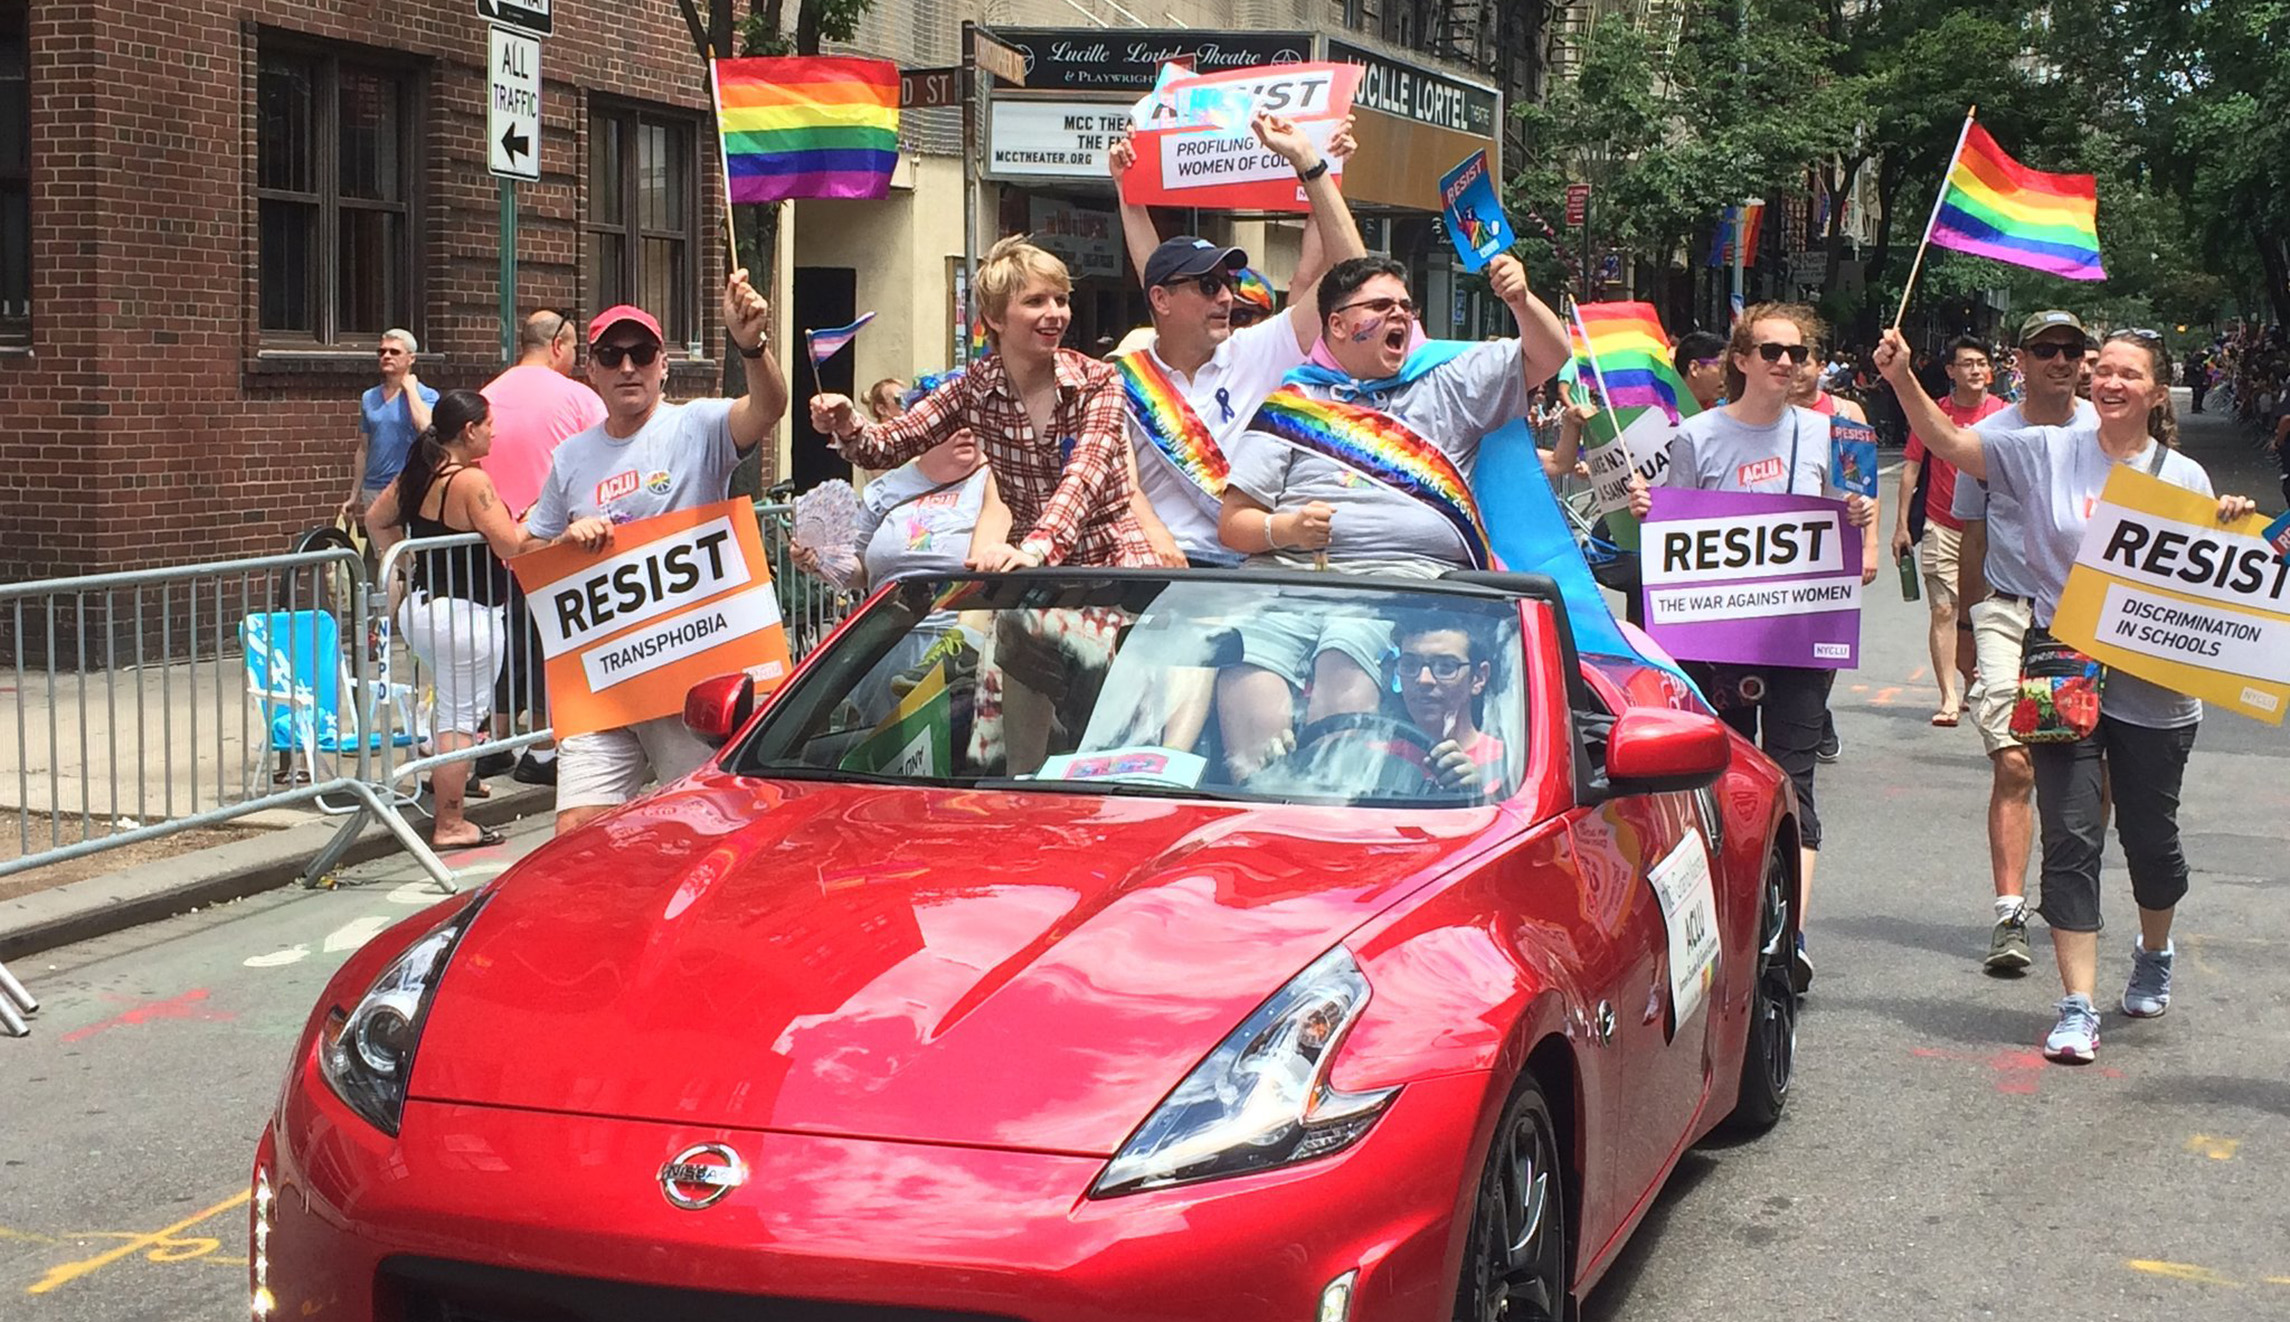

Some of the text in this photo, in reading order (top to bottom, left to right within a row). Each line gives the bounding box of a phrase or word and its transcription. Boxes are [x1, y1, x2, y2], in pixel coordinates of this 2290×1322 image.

[502, 42, 528, 79] ALL
[1047, 41, 1111, 63] Lucille
[1195, 42, 1261, 66] Theatre
[926, 75, 949, 104] ST
[1064, 70, 1154, 84] & PLAYWRIGH
[493, 83, 537, 118] TRAFFIC
[1415, 77, 1468, 130] LORTEL
[1064, 116, 1133, 131] MCC THEA
[1078, 135, 1102, 149] THE
[1177, 136, 1254, 157] PROFILING
[995, 151, 1092, 164] MCCTHEATER.ORG
[1178, 155, 1290, 176] WOMEN OF COL
[1446, 158, 1482, 204] RESIST
[1835, 426, 1871, 442] RESIST
[1742, 459, 1779, 484] ACLU
[600, 472, 637, 502] ACLU
[1663, 521, 1833, 572] RESIST
[2102, 519, 2289, 600] RESIST
[554, 529, 728, 640] RESIST
[1659, 585, 1852, 613] THE WAR AGAINST WOMEN
[2121, 598, 2262, 643] DISCRIMINATION
[600, 613, 728, 674] TRANSPHOBIA
[2116, 619, 2222, 657] IN SCHOOLS
[378, 620, 387, 700] NYPD
